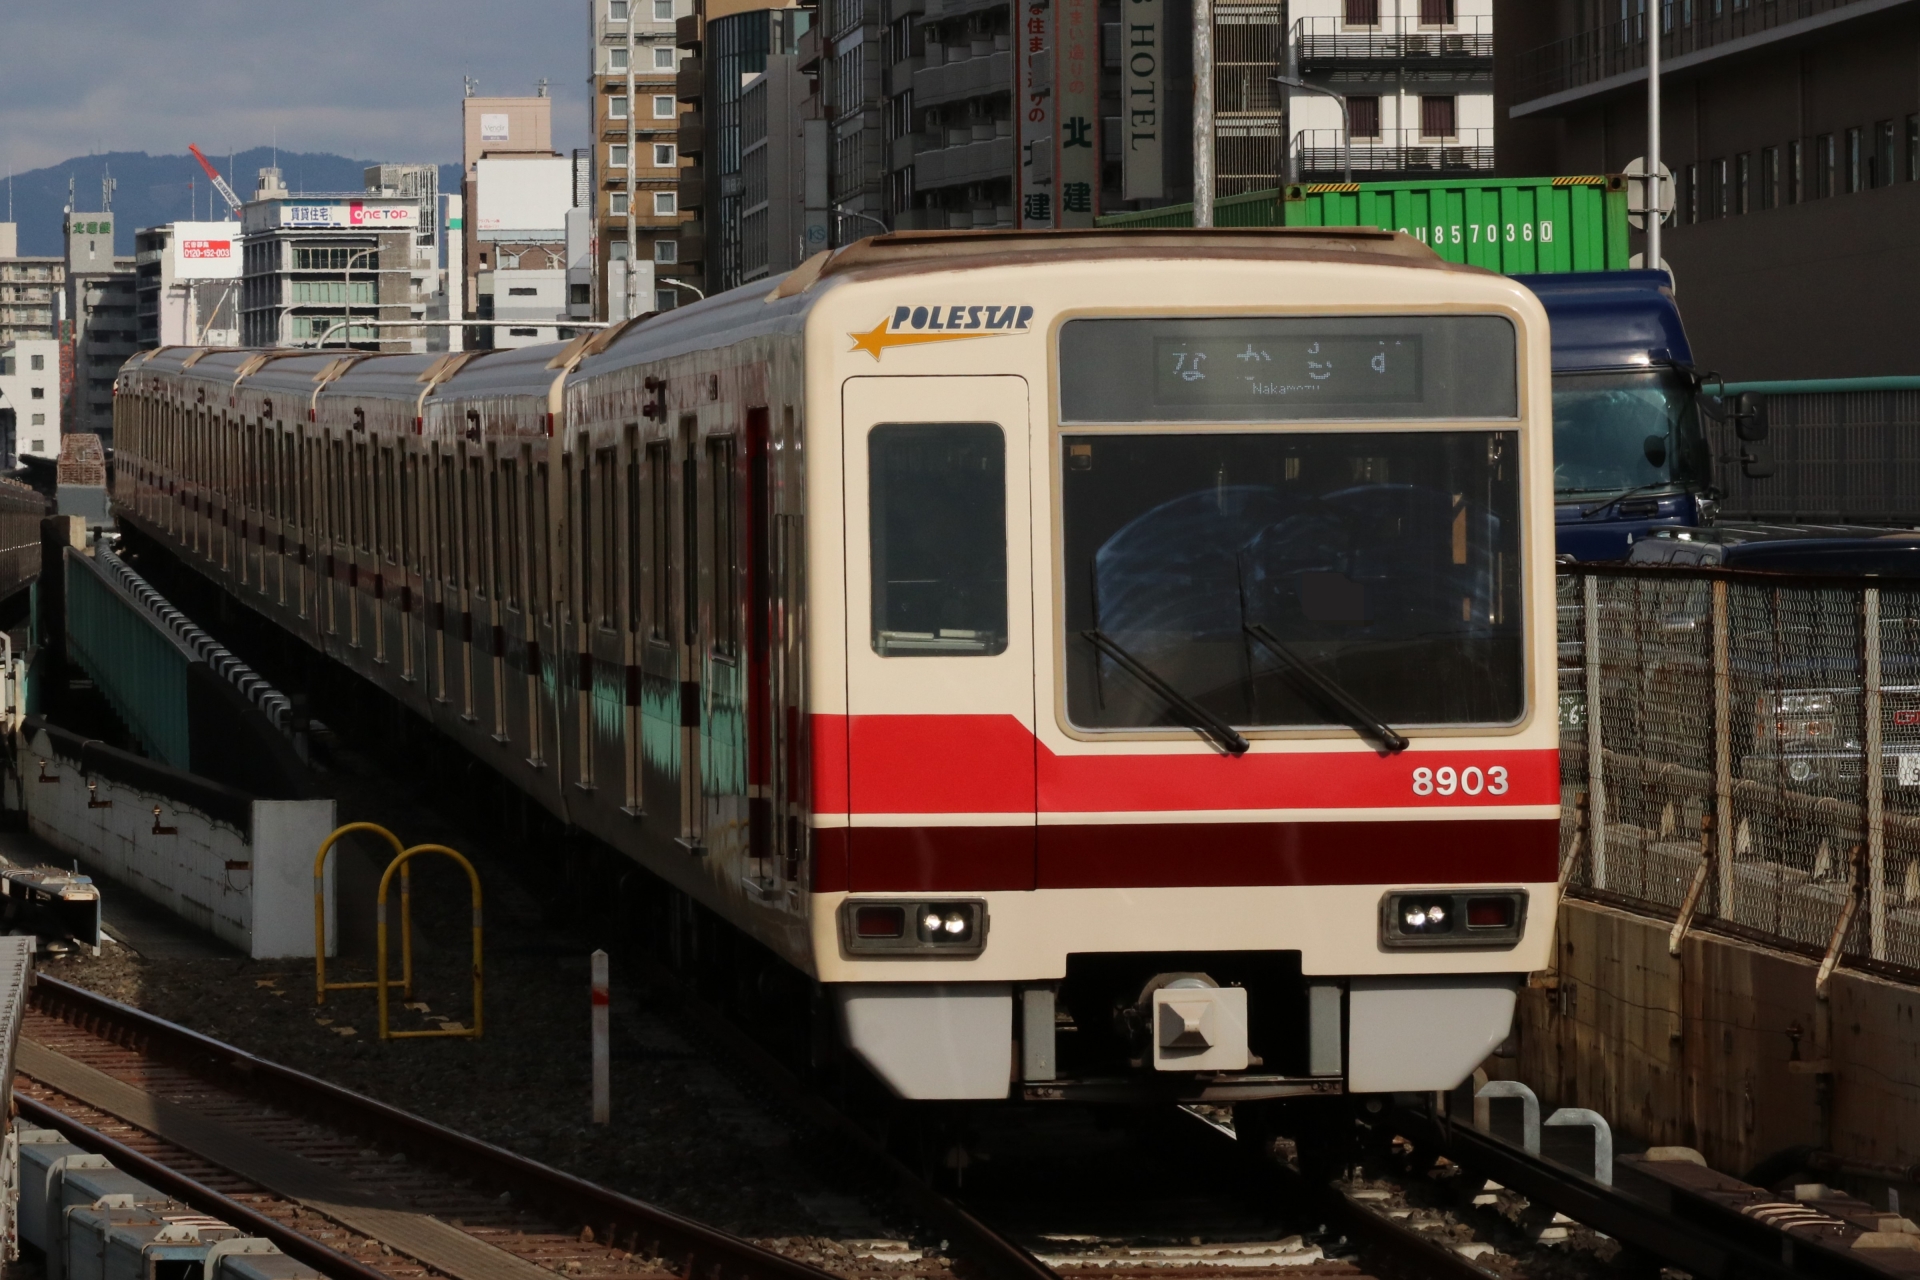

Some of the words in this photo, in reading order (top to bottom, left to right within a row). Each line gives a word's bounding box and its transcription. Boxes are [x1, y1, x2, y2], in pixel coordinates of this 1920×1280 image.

[1130, 22, 1156, 152] HOTEL
[291, 206, 329, 221] 賃貸住宅
[891, 305, 1034, 330] POLESTAR
[1412, 765, 1509, 796] 8903
